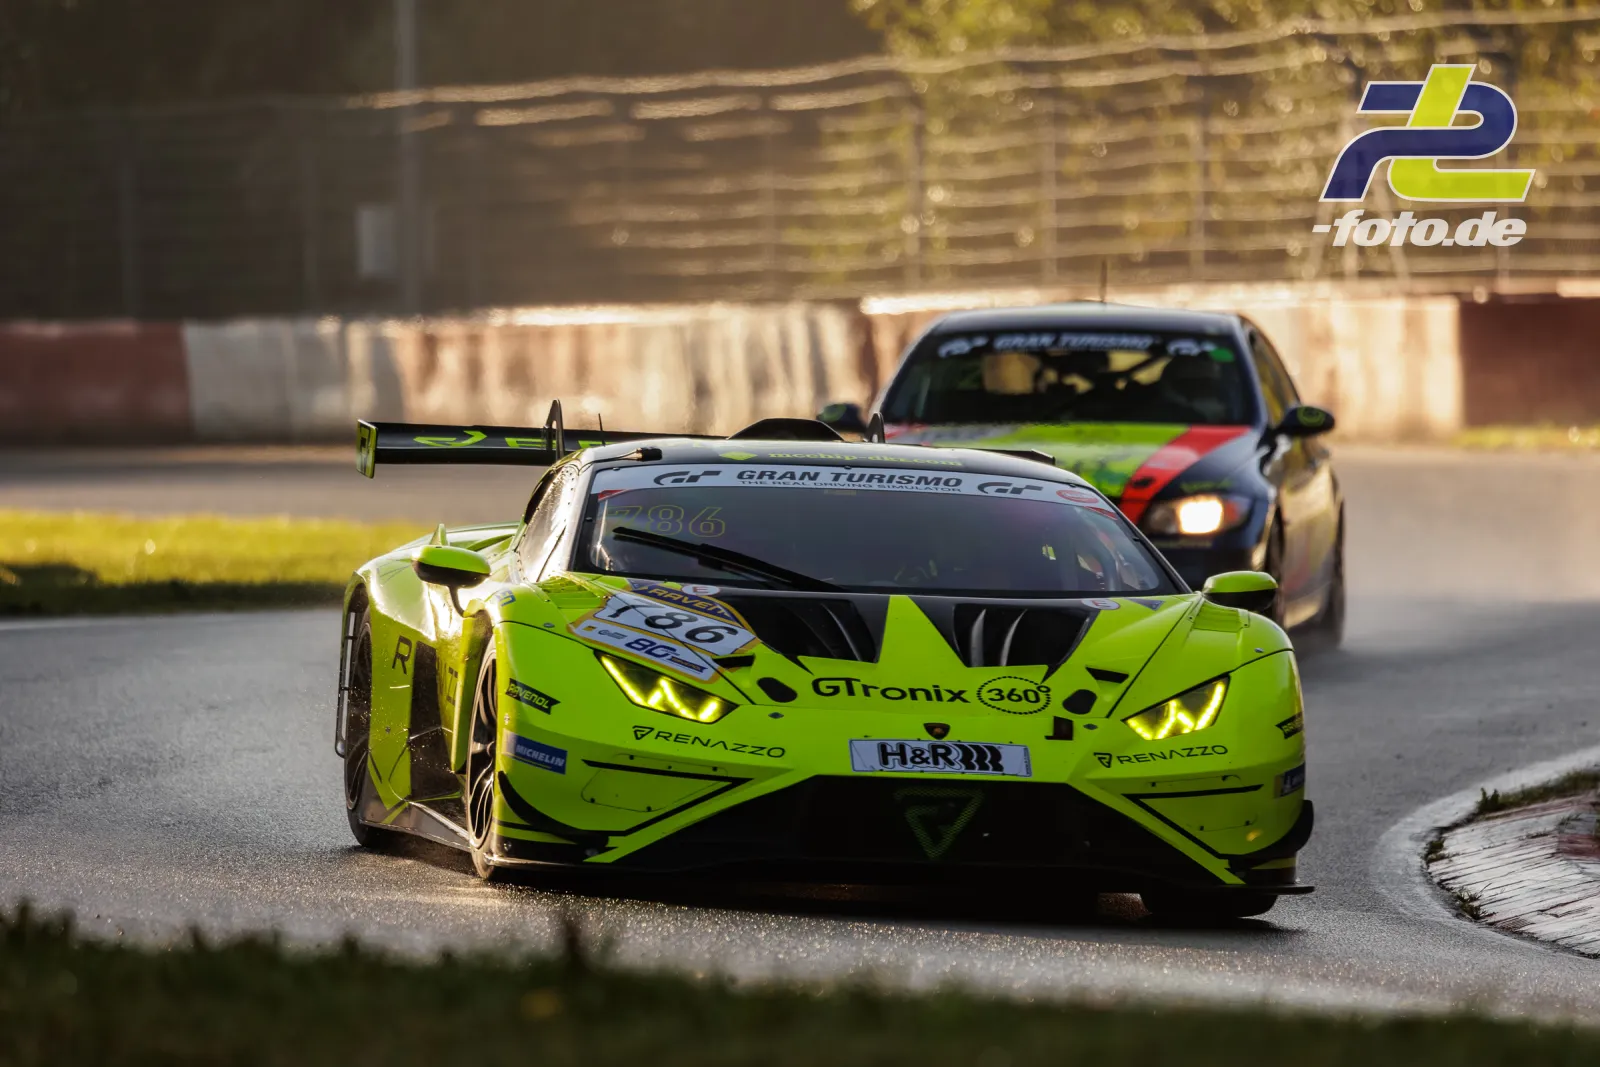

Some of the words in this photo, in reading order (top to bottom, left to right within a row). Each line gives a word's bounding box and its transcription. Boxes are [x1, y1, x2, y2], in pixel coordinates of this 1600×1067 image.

[992, 334, 1055, 349] GRAN
[1058, 333, 1154, 349] TURISMO
[736, 469, 827, 482] GRAN
[830, 472, 963, 488] TURISMO
[877, 484, 962, 492] SIMULATOR
[605, 504, 726, 538] 786
[608, 598, 739, 643] 786
[508, 683, 550, 709] RAVENOL
[515, 744, 566, 767] MICHELIN
[654, 730, 786, 758] RENAZZO
[878, 742, 961, 769] H&R
[1115, 744, 1229, 765] RENAZZO
